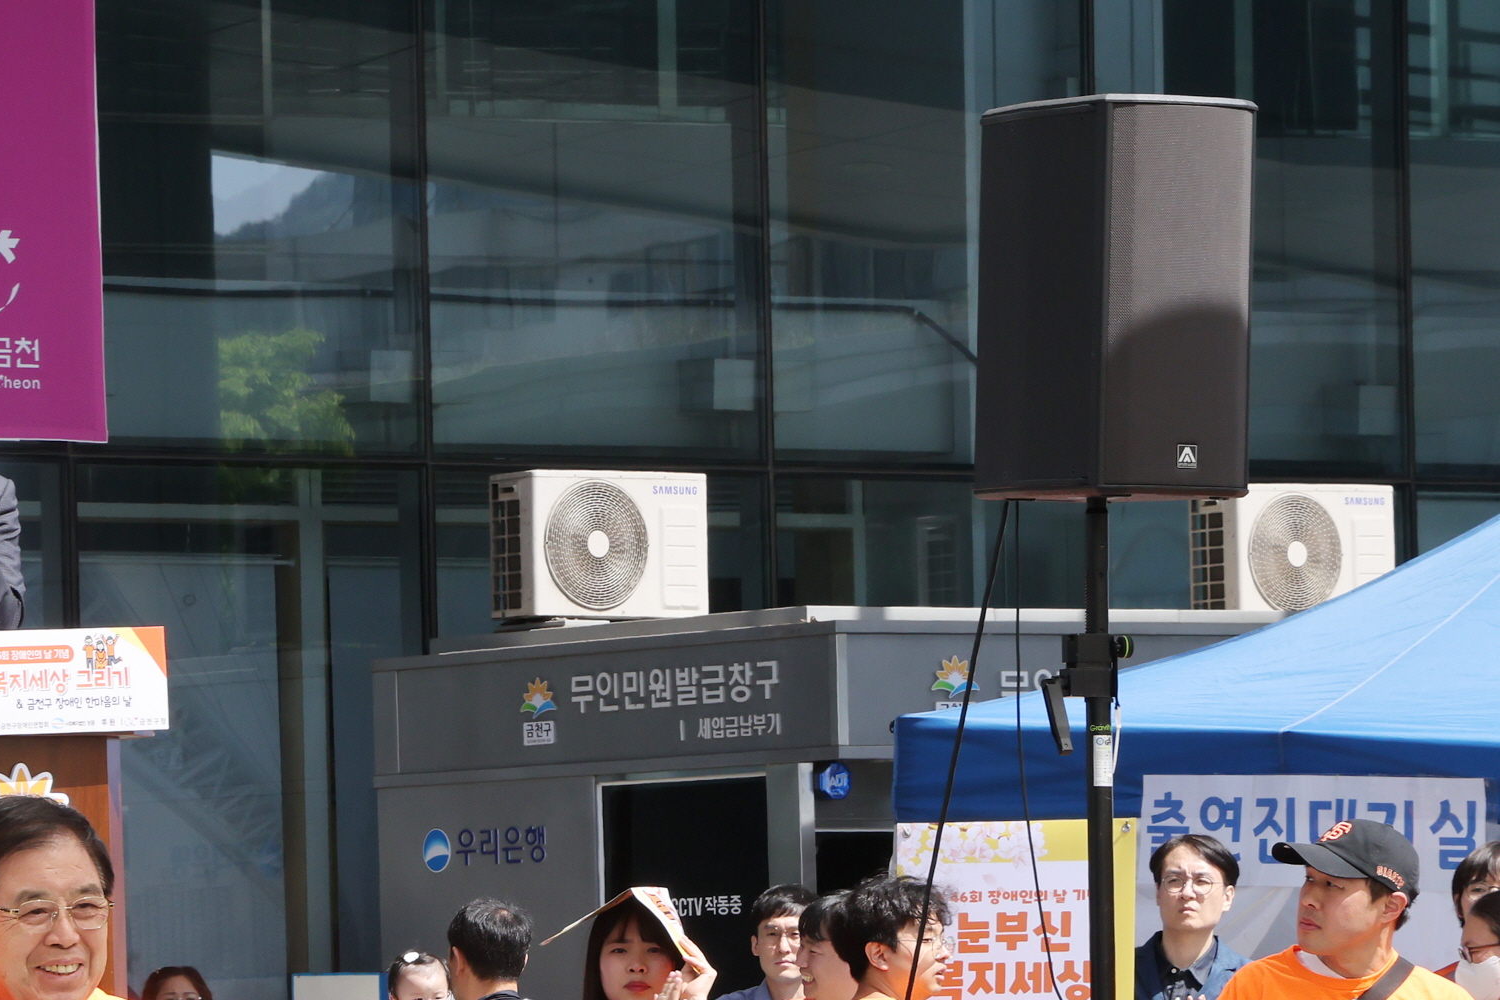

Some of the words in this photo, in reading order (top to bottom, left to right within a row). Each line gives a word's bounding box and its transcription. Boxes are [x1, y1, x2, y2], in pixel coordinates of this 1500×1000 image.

[652, 485, 698, 496] SAMSUNG
[1344, 496, 1386, 506] SAMSUNG
[10, 649, 42, 660] 장애인의
[43, 649, 52, 660] 날
[53, 648, 70, 659] 기념
[75, 666, 132, 691] 그리기
[571, 660, 781, 714] 무인민원발급창구
[16, 699, 24, 709] &
[27, 698, 53, 711] 금천구
[55, 696, 83, 710] 장애인
[85, 695, 121, 708] 한마음의
[122, 694, 133, 707] 날
[525, 722, 552, 739] 금천구
[697, 712, 782, 740] 세입금납부기
[456, 826, 547, 866] 우리은행
[704, 895, 742, 916] 작동중
[987, 889, 1048, 905] 장애인의
[1052, 889, 1067, 903] 날
[1072, 888, 1090, 901] 기
[957, 911, 1072, 954] 눈부신
